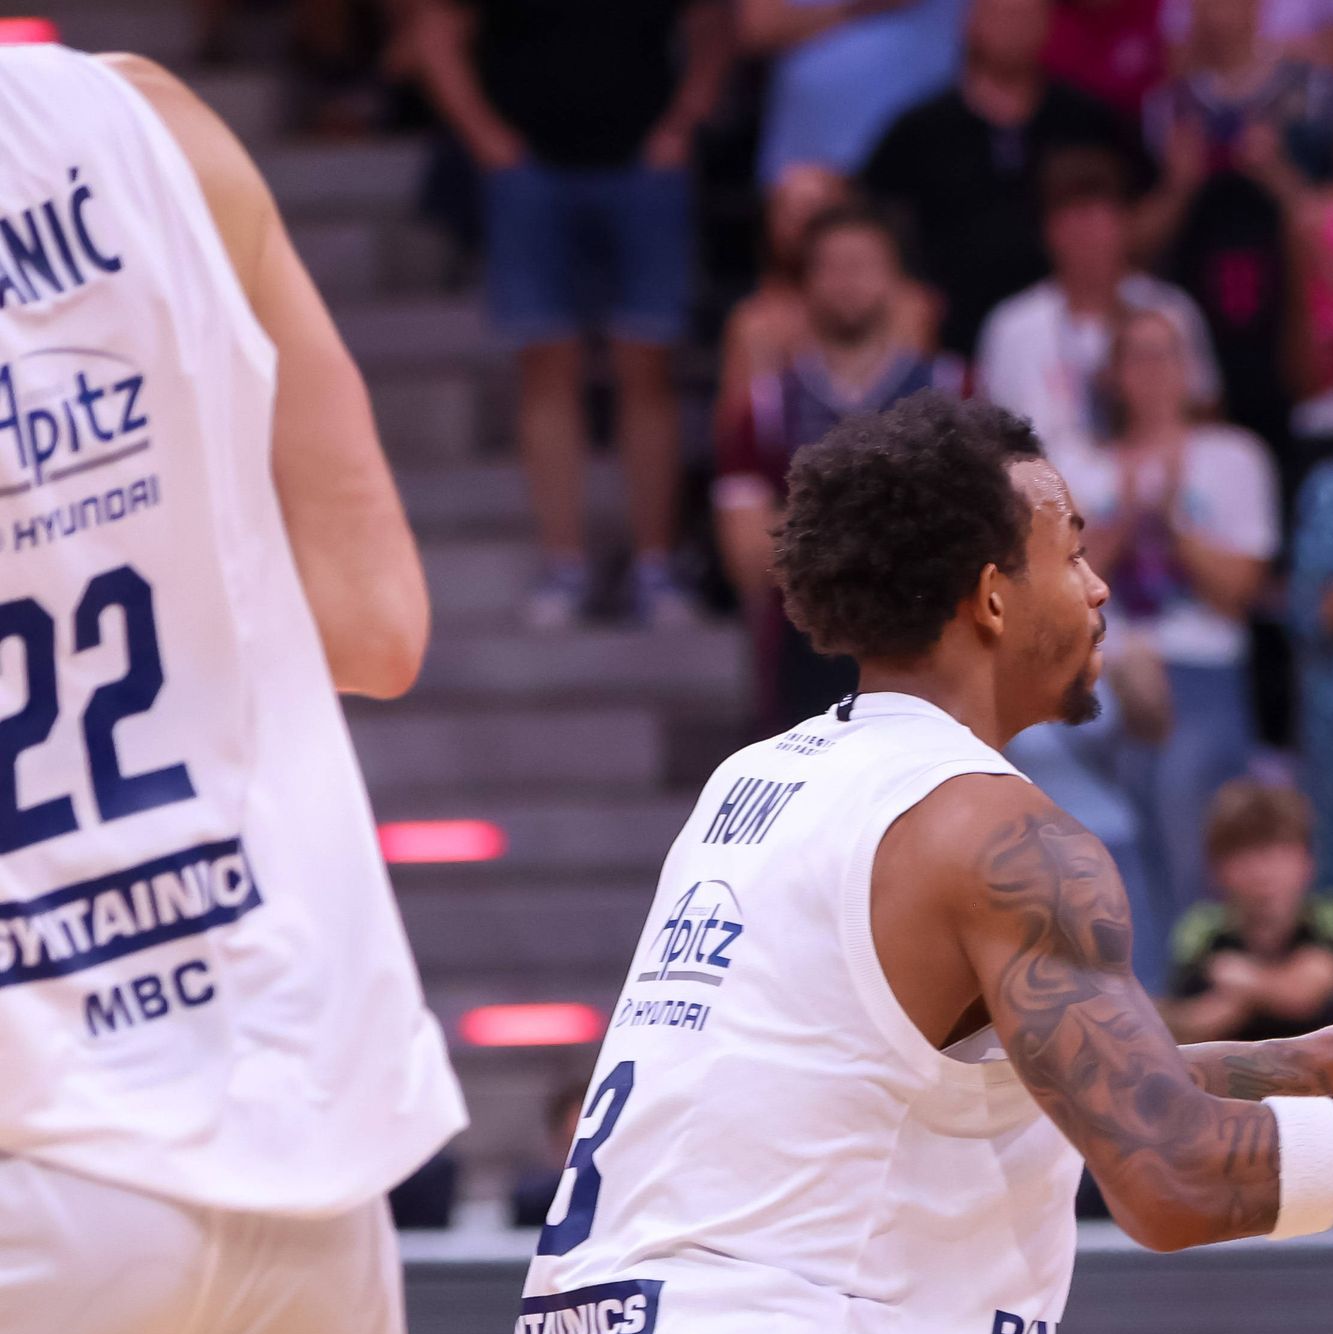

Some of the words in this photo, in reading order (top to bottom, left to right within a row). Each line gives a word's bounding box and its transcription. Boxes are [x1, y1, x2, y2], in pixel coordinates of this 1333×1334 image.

[14, 475, 160, 552] HYUNDAI
[0, 564, 197, 855] 22
[702, 776, 808, 845] HUNT
[84, 960, 216, 1037] MBC
[536, 1061, 636, 1256] 3
